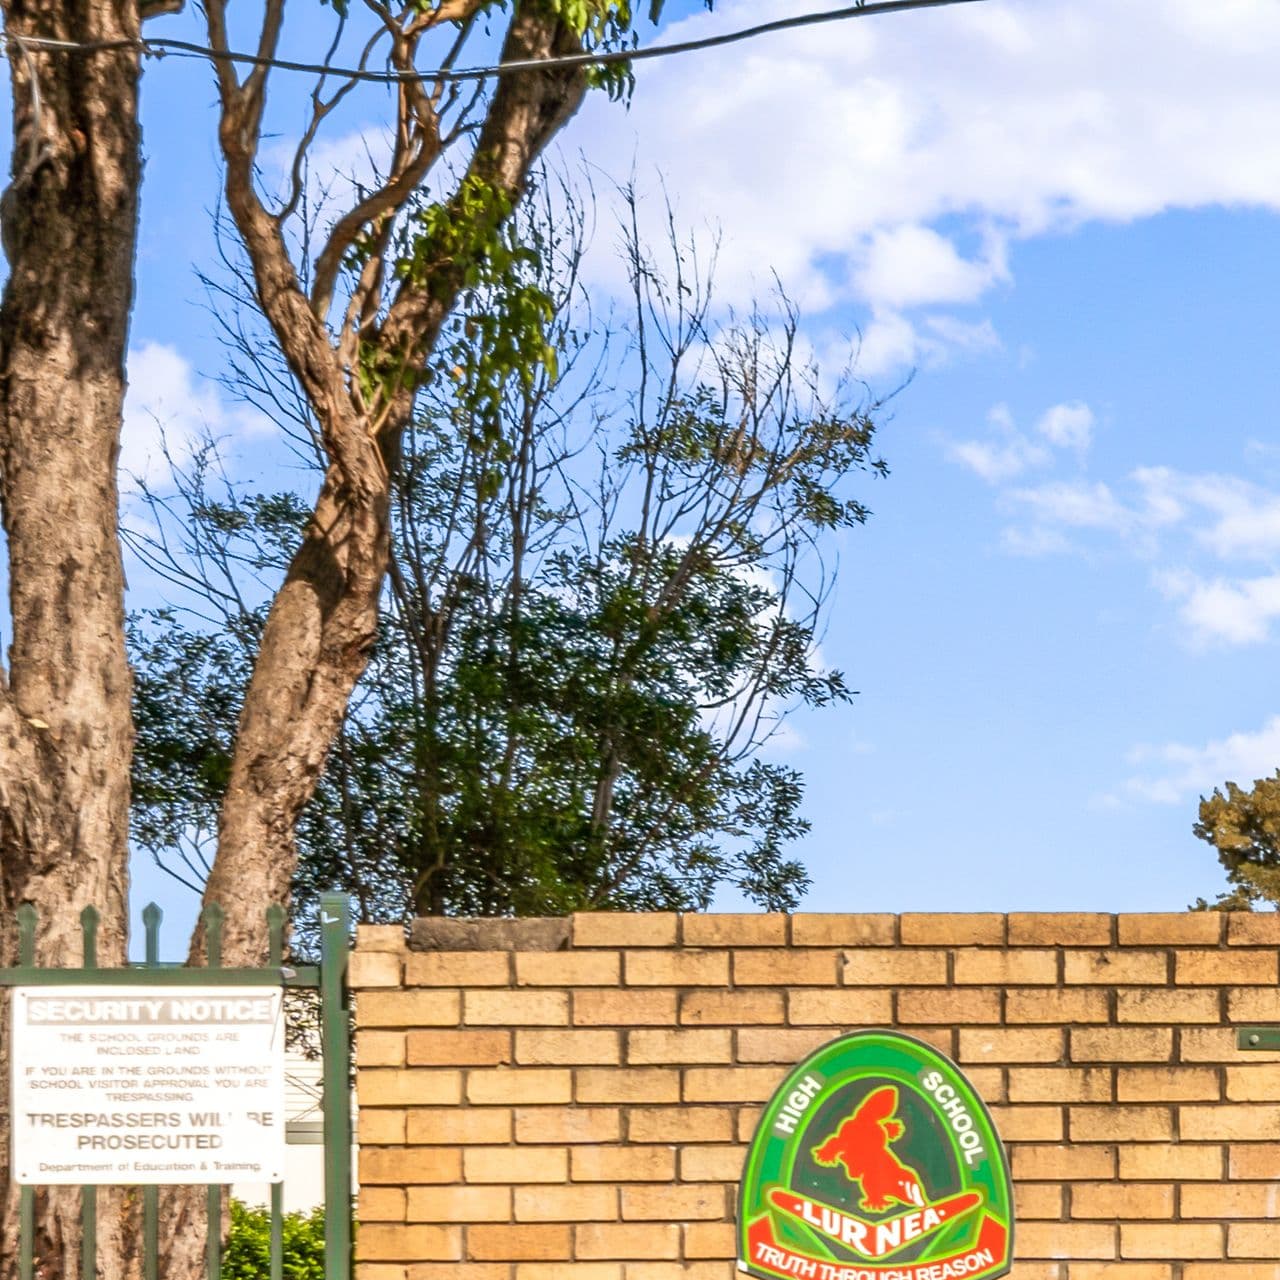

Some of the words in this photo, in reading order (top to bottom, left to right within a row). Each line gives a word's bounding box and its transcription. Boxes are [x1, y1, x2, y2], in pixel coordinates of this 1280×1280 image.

[30, 999, 163, 1021] SECURITY
[171, 999, 272, 1020] NOTICE
[60, 1033, 83, 1042] THE
[89, 1033, 141, 1042] SCHOOL
[147, 1032, 209, 1042] GROUNDS
[215, 1032, 240, 1042] ARE
[96, 1046, 161, 1056] INCLOSED
[25, 1066, 36, 1076] IF
[41, 1066, 66, 1076] YOU
[72, 1066, 96, 1076] ARE
[101, 1066, 114, 1076] IN
[118, 1066, 142, 1076] THE
[147, 1066, 209, 1076] GROUNDS
[215, 1066, 272, 1076] WITHOUT
[30, 1079, 83, 1089] SCHOOL
[89, 1079, 139, 1089] VISITOR
[143, 1079, 210, 1089] APPROVAL
[215, 1079, 240, 1089] YOU
[244, 1079, 269, 1089] ARE
[26, 1112, 181, 1128] TRESPASSERS
[774, 1076, 821, 1134] HIGH
[922, 1071, 984, 1165] SCHOOL
[77, 1134, 223, 1150] PROSECUTED
[39, 1162, 113, 1174] Department
[134, 1161, 196, 1172] Education
[213, 1161, 262, 1172] Training
[800, 1201, 943, 1256] LURNEA
[755, 1242, 817, 1279] TRUTH
